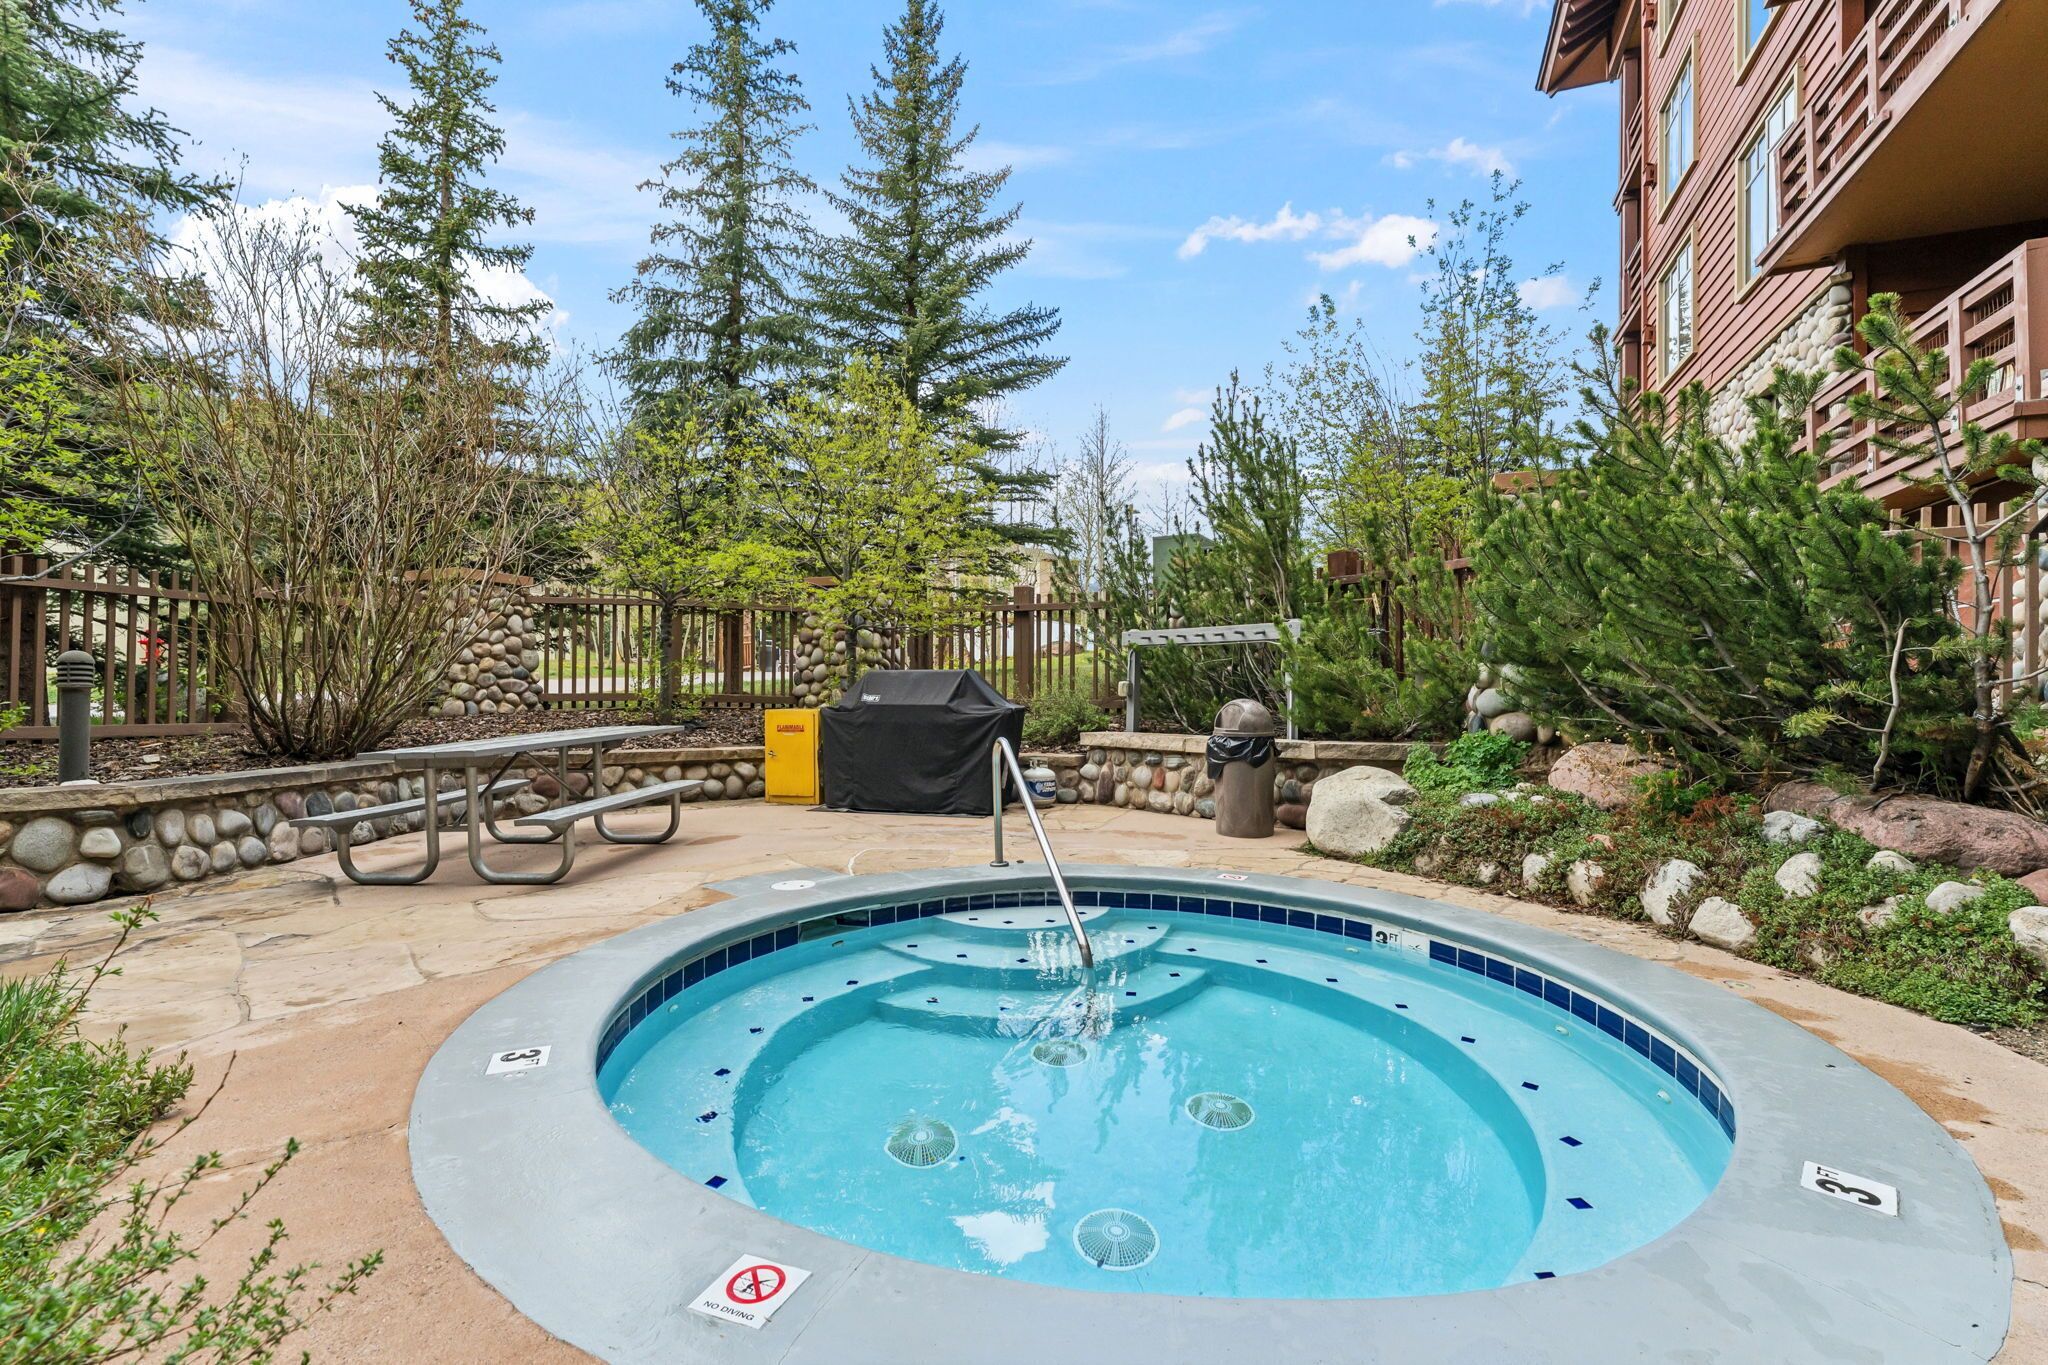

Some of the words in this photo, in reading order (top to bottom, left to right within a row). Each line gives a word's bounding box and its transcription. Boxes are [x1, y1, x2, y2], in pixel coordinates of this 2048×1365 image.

[1389, 933, 1398, 942] FT
[500, 1049, 541, 1062] 3
[1817, 1166, 1839, 1181] FT
[1815, 1179, 1882, 1206] 3
[704, 1301, 719, 1310] NO
[720, 1306, 755, 1321] DIVING
